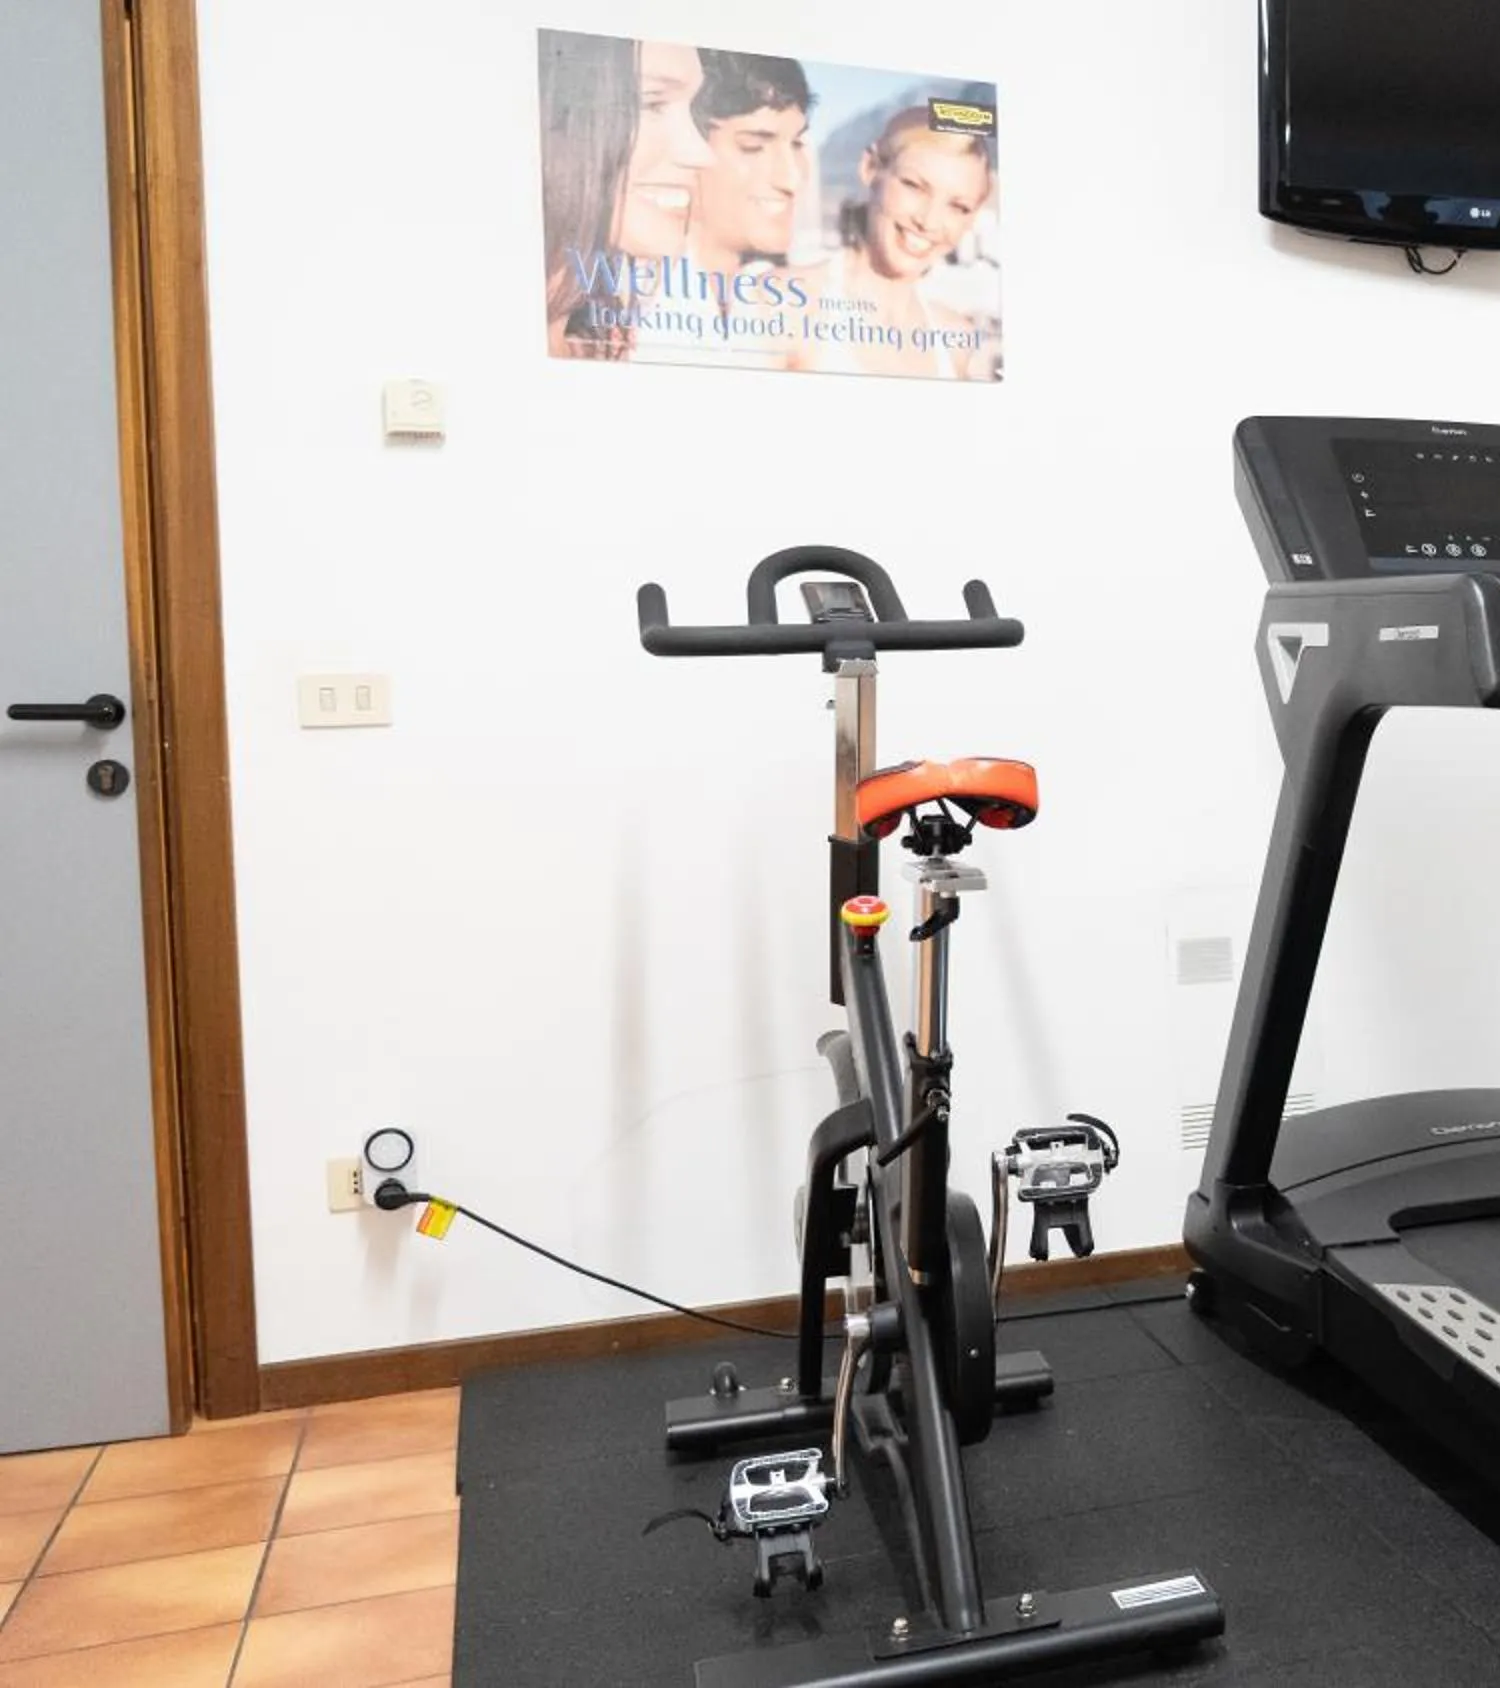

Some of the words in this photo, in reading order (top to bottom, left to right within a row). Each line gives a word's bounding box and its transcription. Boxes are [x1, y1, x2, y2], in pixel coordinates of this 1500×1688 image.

[567, 247, 808, 309] Wellness
[819, 297, 877, 312] means
[590, 300, 703, 340] looking
[803, 313, 902, 351] feeling
[911, 325, 985, 352] great
